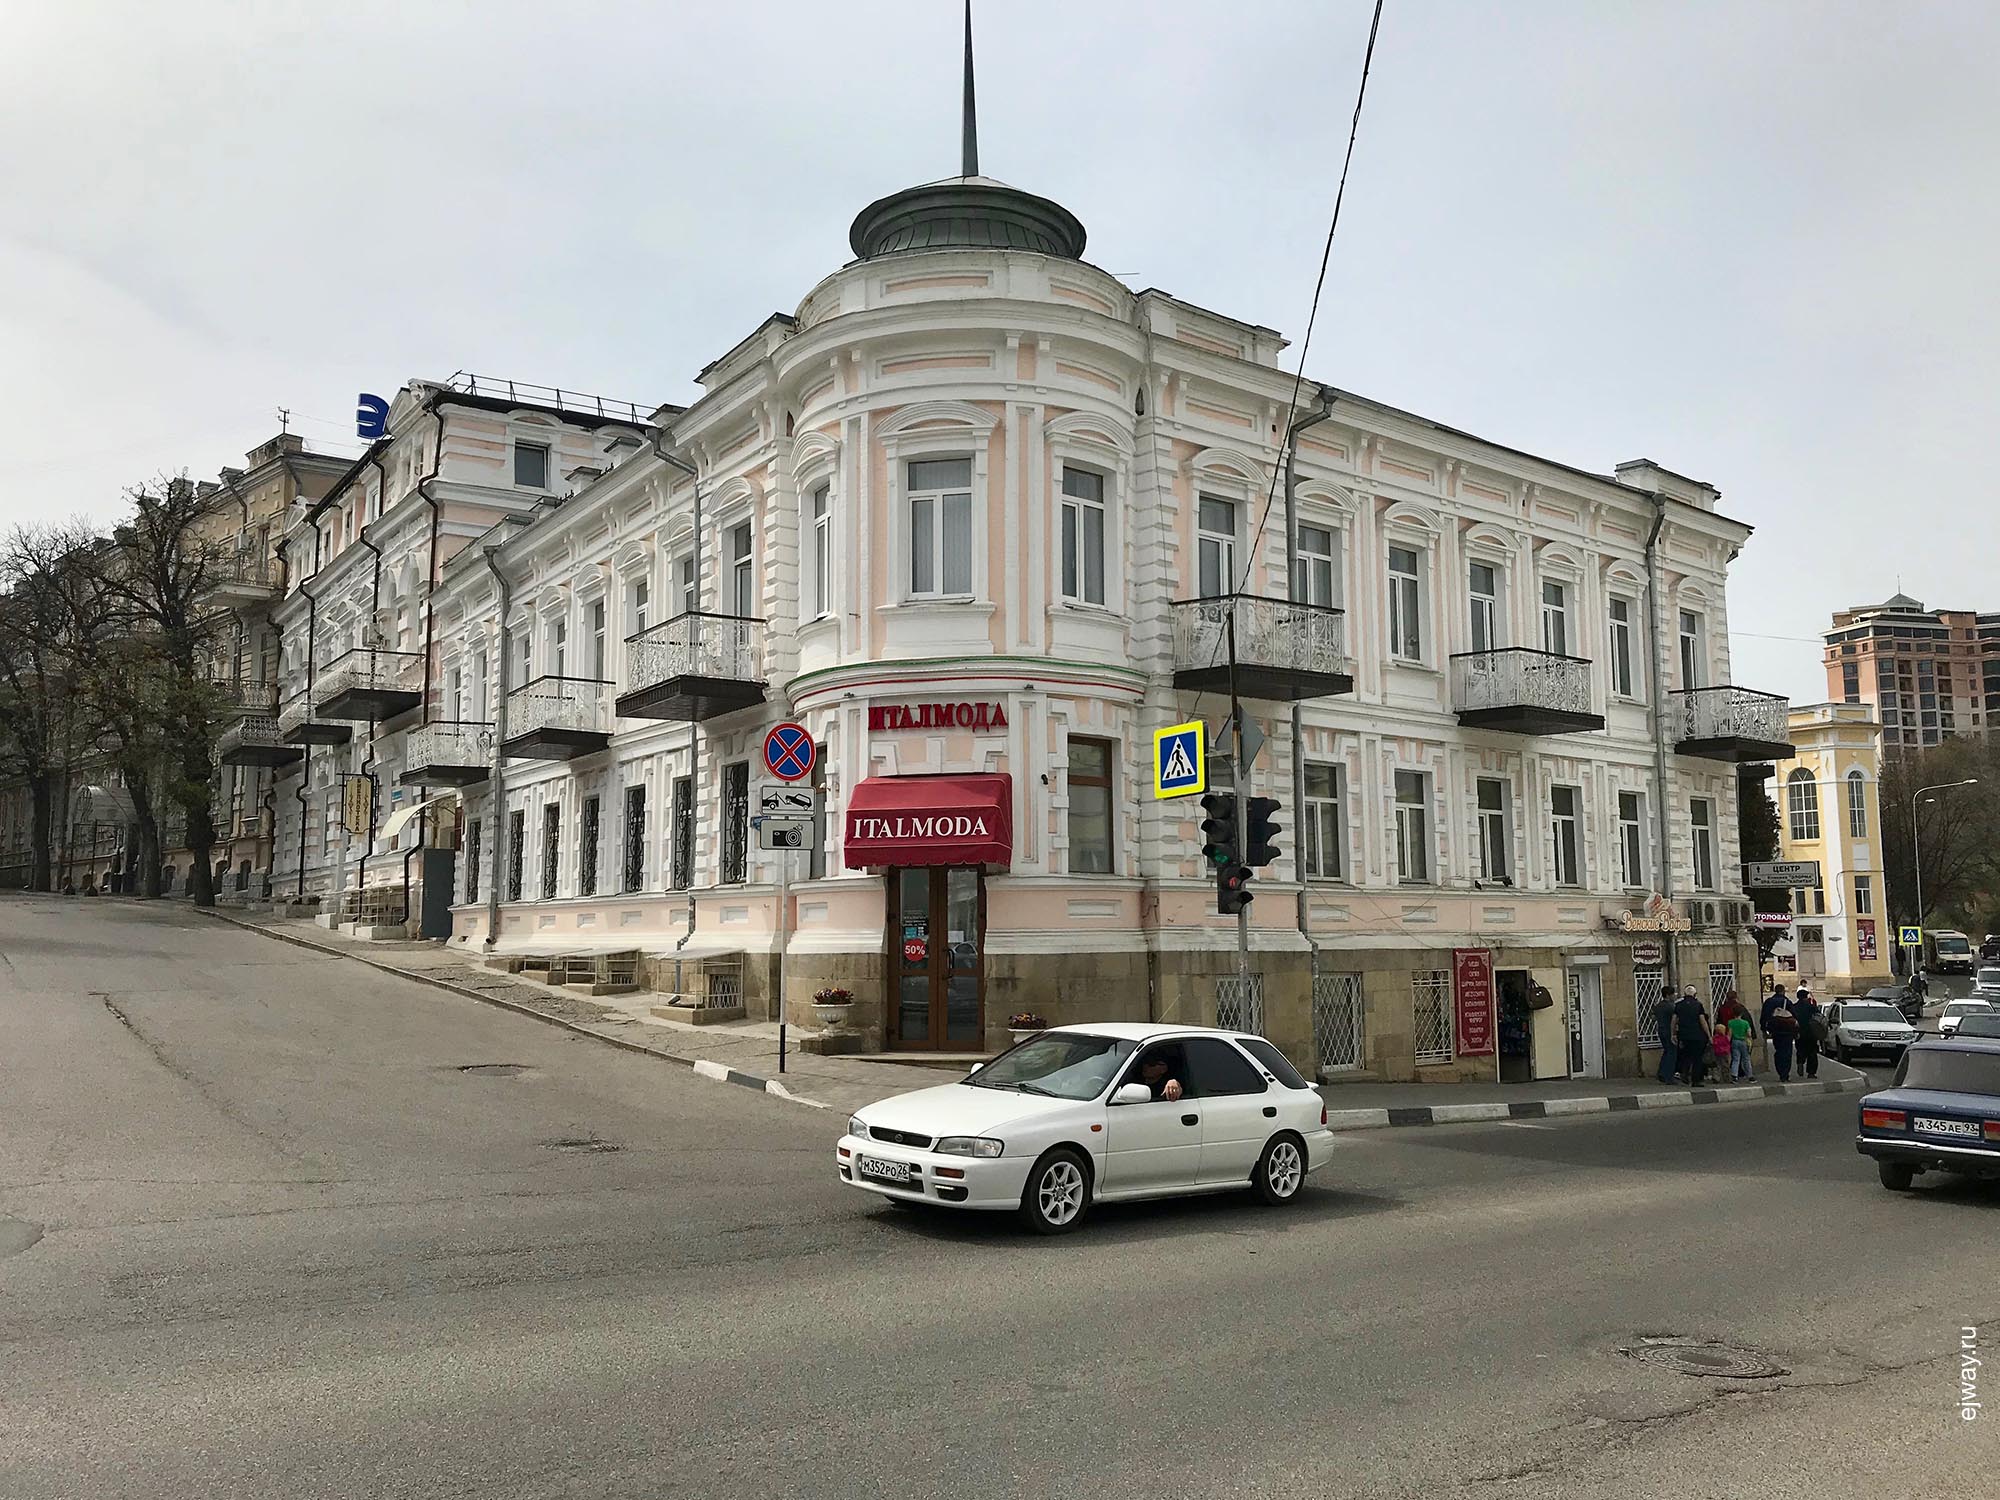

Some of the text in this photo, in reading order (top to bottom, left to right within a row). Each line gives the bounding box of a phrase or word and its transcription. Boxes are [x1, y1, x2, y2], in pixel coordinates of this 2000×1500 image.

[868, 702, 1009, 732] ИТАЛМОДА
[853, 816, 989, 839] ITALMODA
[905, 945, 926, 955] 50%
[1918, 1120, 1976, 1133] А345АЕ 93
[863, 1160, 907, 1177] М352РО 26
